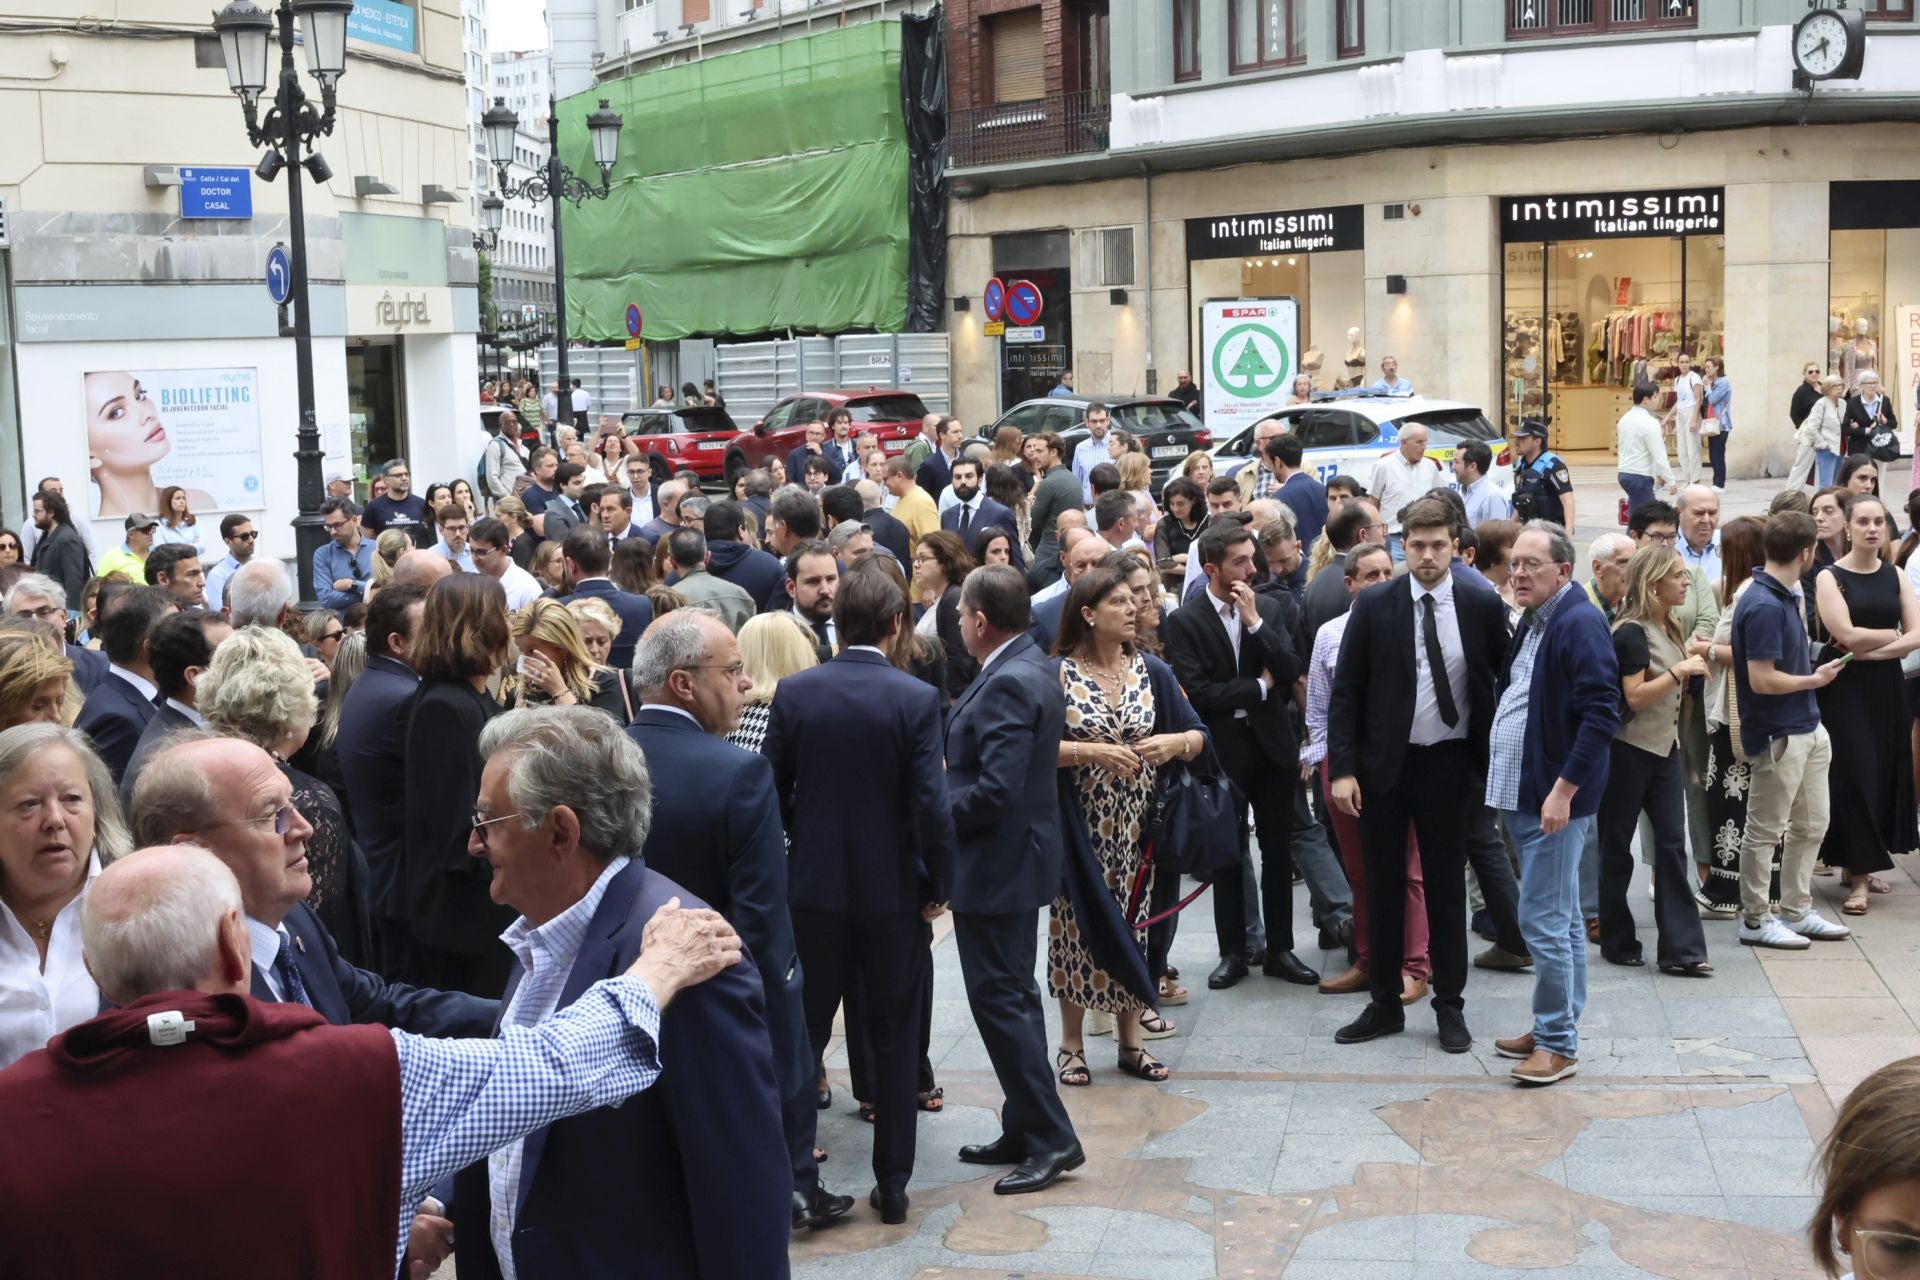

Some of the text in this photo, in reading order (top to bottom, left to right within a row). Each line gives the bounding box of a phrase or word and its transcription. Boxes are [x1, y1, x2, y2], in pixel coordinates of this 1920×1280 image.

[200, 175, 216, 183] Calle
[200, 187, 232, 197] DOCTOR
[204, 201, 231, 211] CASAL
[1512, 194, 1719, 221] intimissimi
[1211, 213, 1334, 239] intimissimi
[1594, 214, 1719, 233] Italian lingerie
[1260, 234, 1334, 251] Italian lingerie
[25, 311, 99, 322] Rejuvenecimiento
[1231, 307, 1267, 317] SPAR
[25, 323, 50, 335] facial
[1009, 352, 1063, 363] intiissimi
[160, 386, 251, 406] BIOLIFTING
[161, 403, 229, 413] REJUVENECEDOR FACIAL
[1445, 450, 1457, 458] 09
